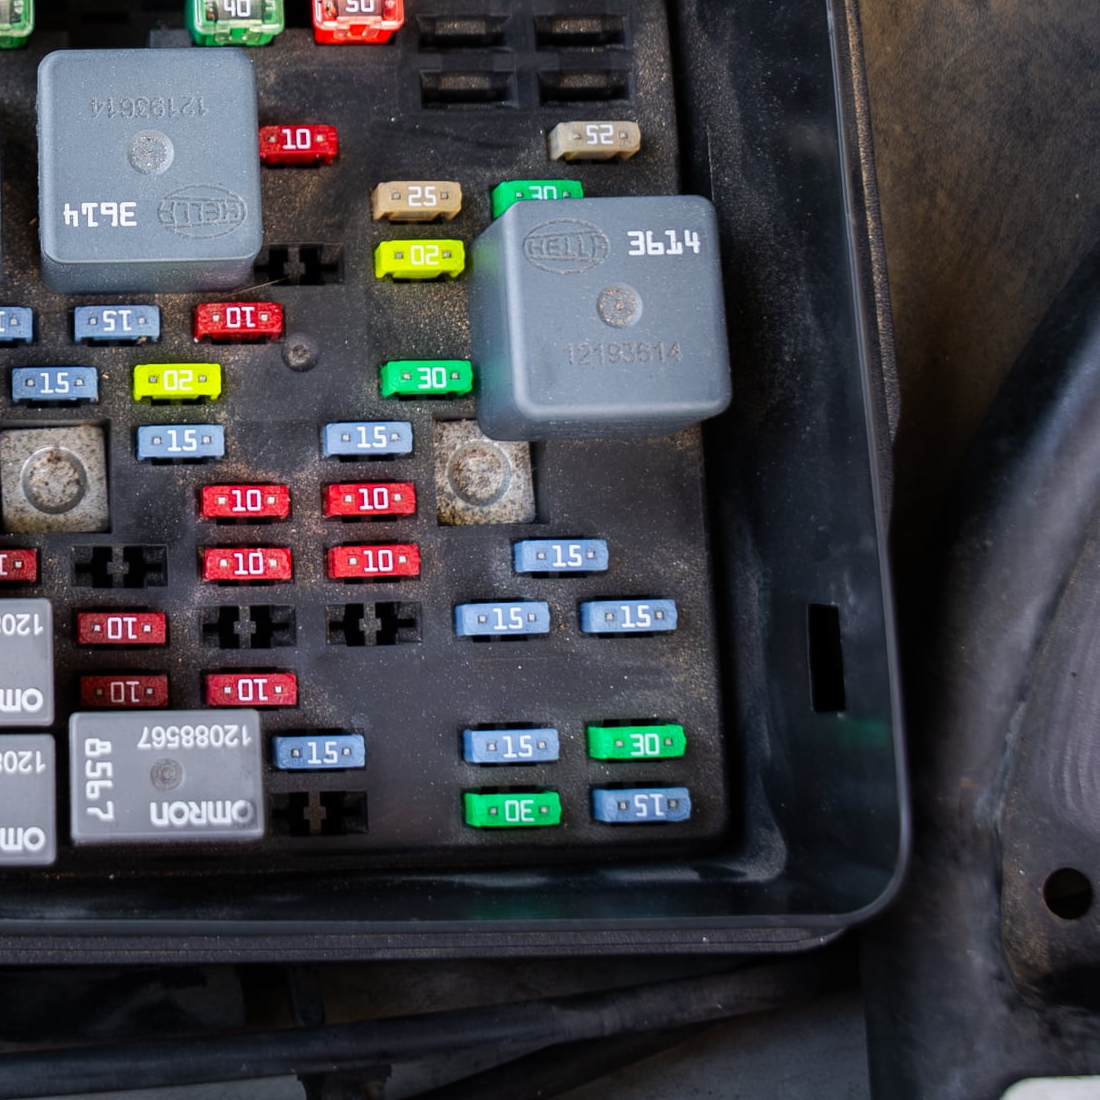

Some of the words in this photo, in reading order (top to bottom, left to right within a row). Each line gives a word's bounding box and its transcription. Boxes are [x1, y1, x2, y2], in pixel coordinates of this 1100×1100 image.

[283, 129, 310, 149] 10
[586, 124, 614, 145] 25
[408, 185, 437, 207] 25
[63, 202, 137, 228] 3614
[627, 229, 701, 256] 3614
[411, 245, 438, 265] 20
[103, 310, 132, 331] 15
[226, 306, 255, 328] 10
[40, 372, 69, 393] 15
[164, 370, 192, 390] 20
[418, 367, 446, 389] 30
[167, 429, 197, 452] 15
[356, 426, 387, 448] 15
[232, 489, 261, 511] 10
[359, 487, 388, 510] 10
[234, 552, 264, 575] 10
[363, 549, 393, 572] 10
[552, 544, 582, 567] 15
[493, 607, 523, 630] 15
[620, 605, 651, 628] 15
[107, 617, 137, 639] 10
[110, 681, 140, 703] 10
[238, 678, 268, 701] 10
[137, 724, 252, 749] 12088567
[503, 735, 533, 758] 15
[631, 734, 659, 755] 30
[308, 741, 338, 764] 15
[84, 738, 114, 821] 8567
[505, 800, 534, 821] 30
[634, 794, 662, 816] 15
